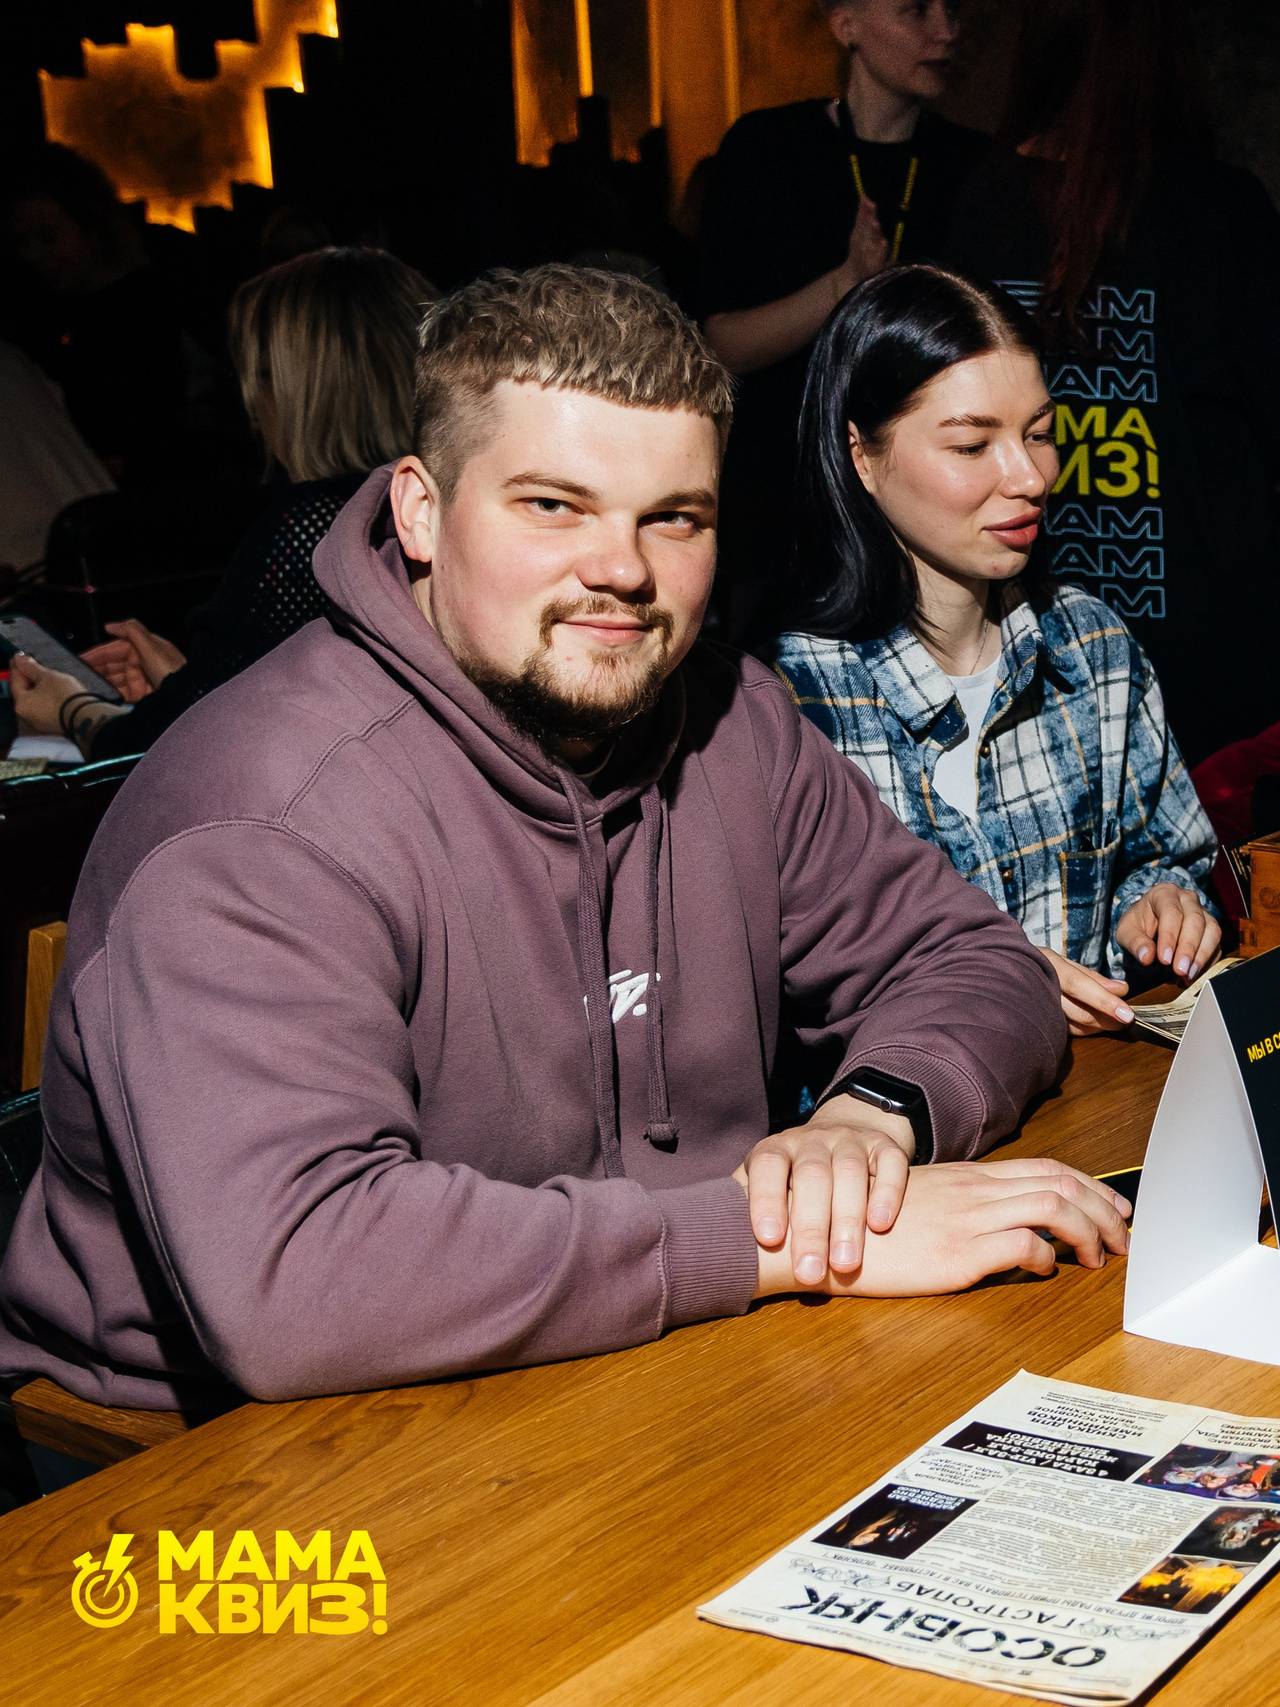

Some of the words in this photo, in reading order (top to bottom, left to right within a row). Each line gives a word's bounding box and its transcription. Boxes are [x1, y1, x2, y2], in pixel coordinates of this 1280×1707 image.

[1246, 1041, 1266, 1063] МЫ
[1264, 1037, 1274, 1054] В
[1031, 1405, 1100, 1421] ОСНОВНОЕ
[1055, 1405, 1096, 1415] КУХНИ
[1097, 1414, 1135, 1423] МЕНЮ
[1024, 1410, 1144, 1436] ИМЕНИННИКОВ
[1029, 1417, 1064, 1427] ДЛЯ
[1064, 1424, 1128, 1439] СКИДКА
[1221, 1435, 1270, 1443] ВКУСНАЯ
[981, 1433, 1057, 1451] МУЗЫКА
[1003, 1431, 1110, 1455] ЕЖЕДНЕВНО!
[970, 1446, 1039, 1463] VIP-ЗАЛ
[985, 1441, 1099, 1467] КАРАОКЕ-ЗАЛ
[1053, 1446, 1118, 1463] ЖИВАЯ
[1048, 1461, 1098, 1474] ЗАЛА
[885, 1493, 956, 1510] КАРАОКЕ-ЗАЛ
[890, 1489, 962, 1506] ЕЖЕДНЕВНО
[949, 1578, 973, 1587] ВАС
[896, 1581, 1077, 1630] ГАСТРОПАБ
[1058, 1599, 1094, 1609] РАДЫ
[777, 1585, 1106, 1667] ОСОБНЯК
